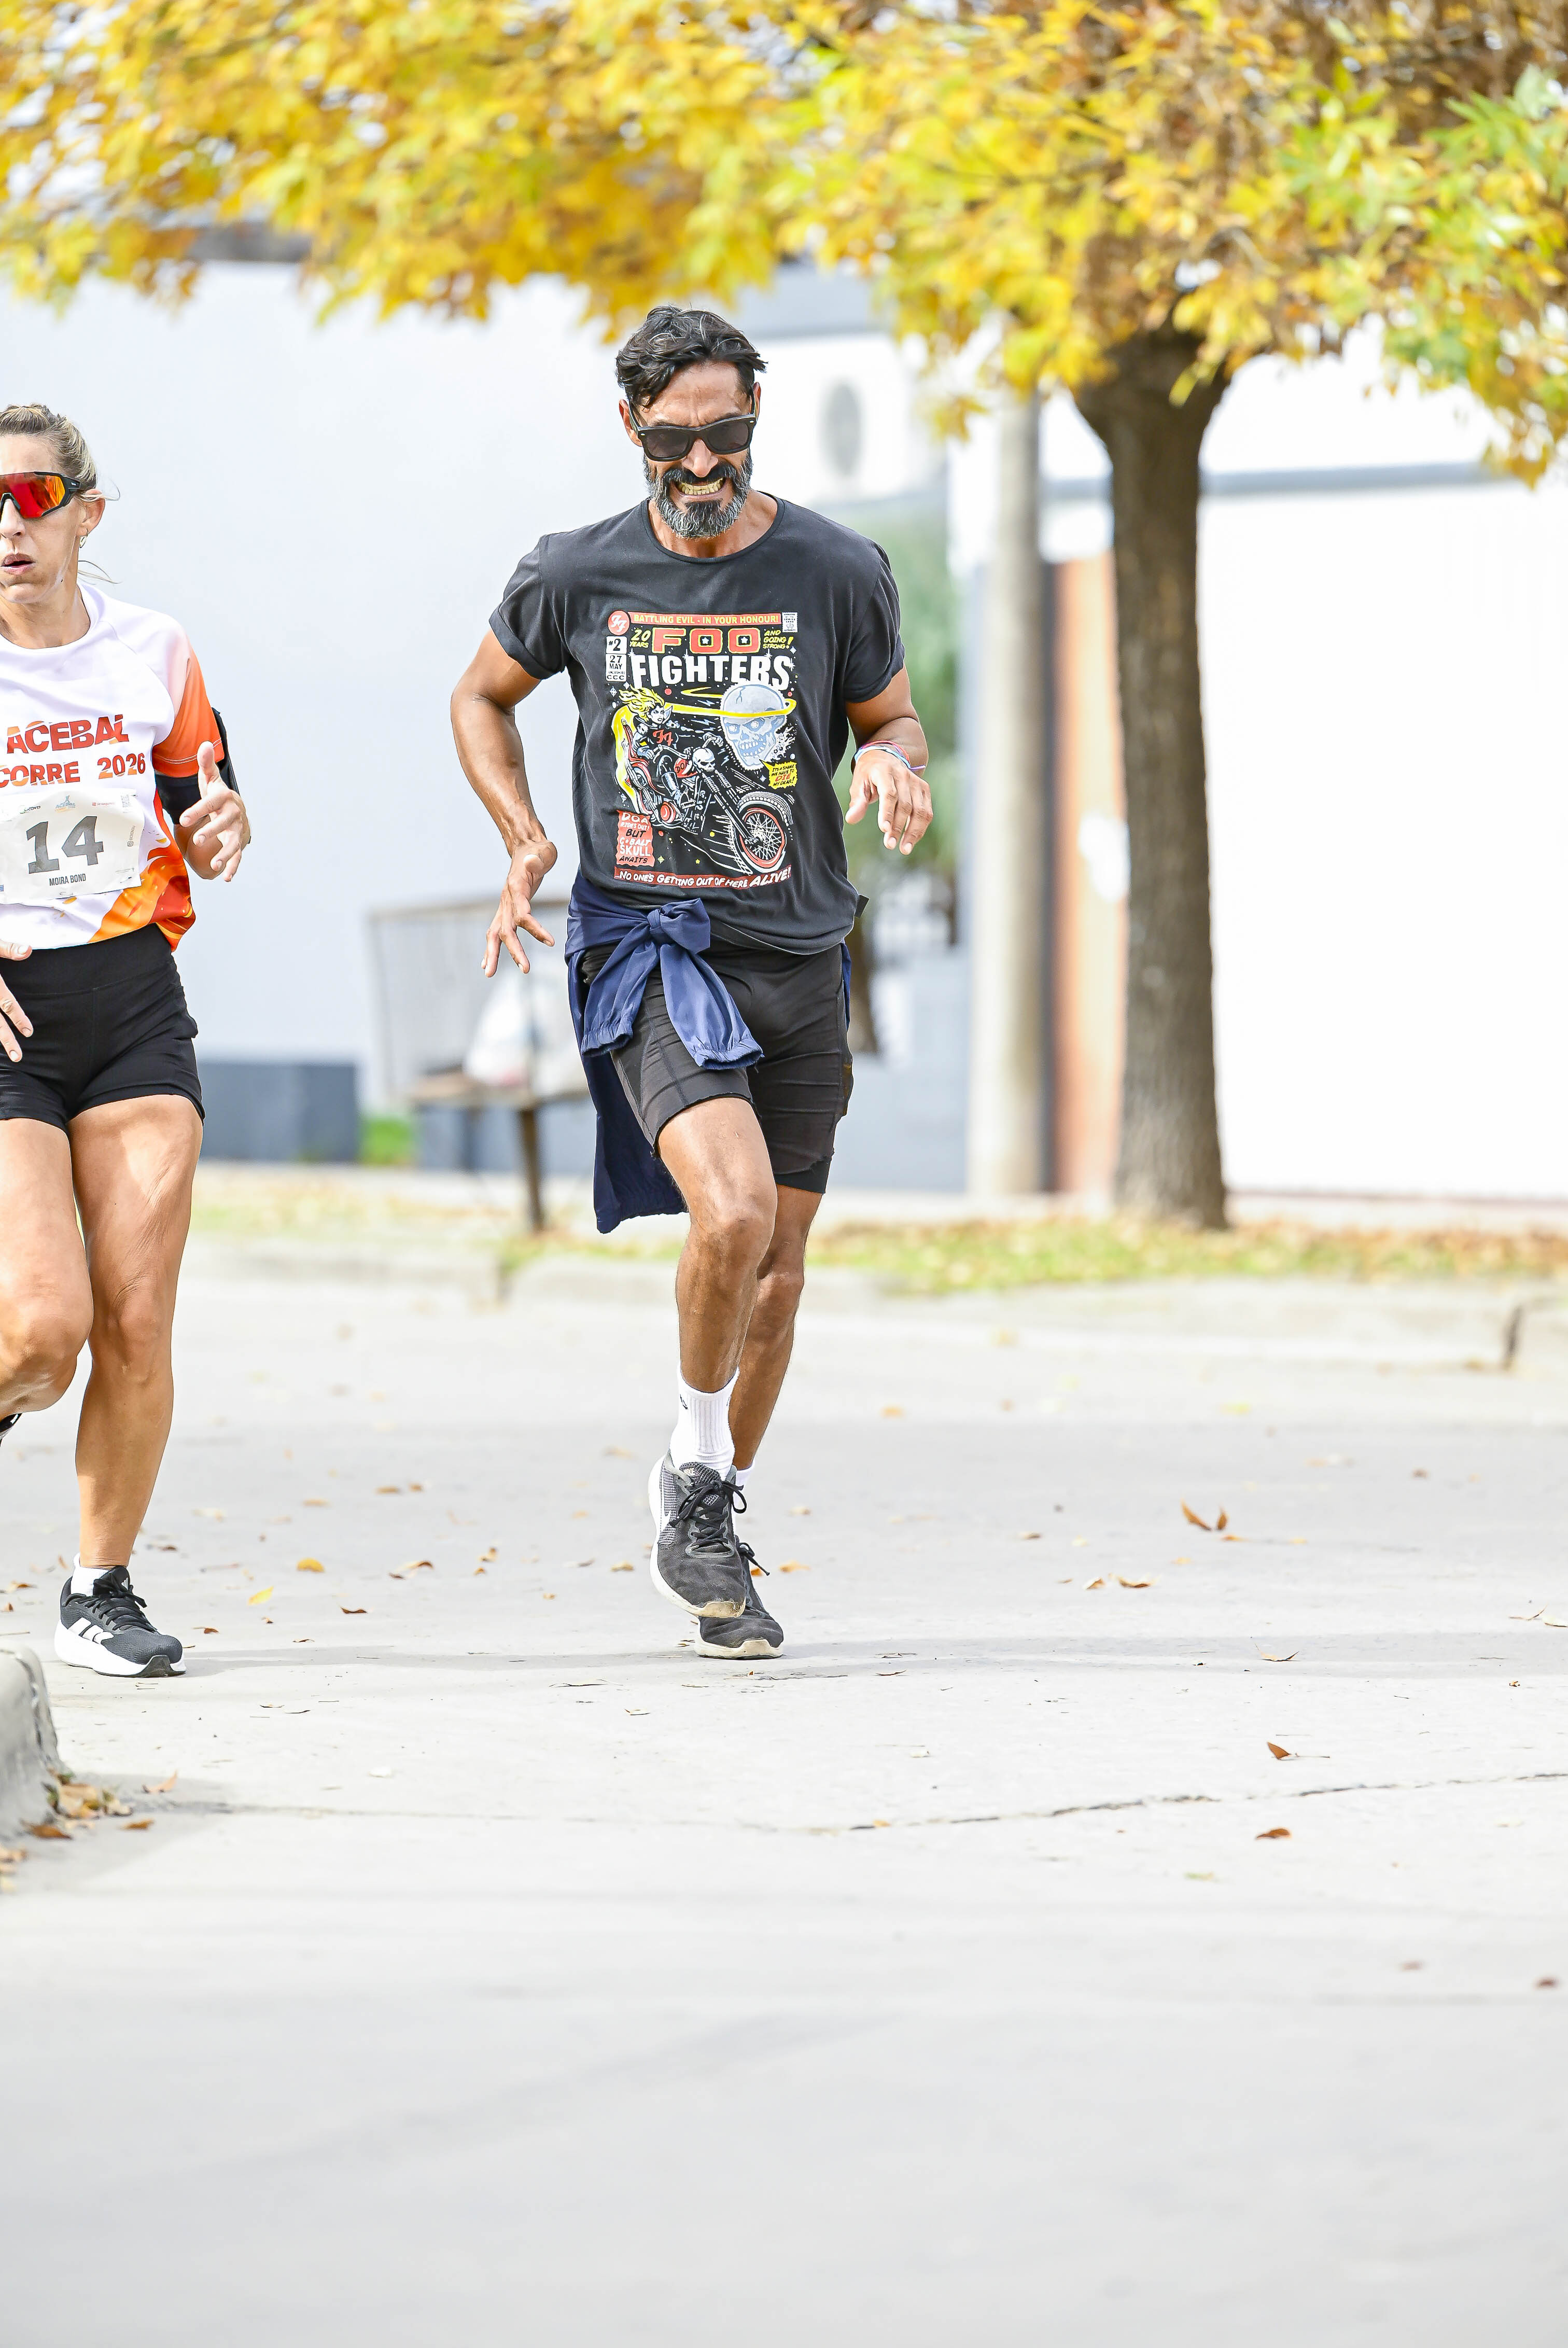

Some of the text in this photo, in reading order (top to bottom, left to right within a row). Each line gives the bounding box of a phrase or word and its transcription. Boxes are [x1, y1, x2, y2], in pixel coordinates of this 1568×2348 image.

[634, 614, 674, 623] BATTLING
[739, 615, 778, 623] HONOUR!
[631, 629, 651, 642] 20
[652, 627, 761, 654] FOO
[608, 638, 621, 651] #2
[629, 640, 649, 649] YEARS
[610, 655, 622, 663] 27
[631, 654, 791, 691] FIGHTERS
[7, 714, 130, 754] ACEBAL
[0, 752, 146, 788] CORRE 2026
[625, 829, 647, 838] BUT
[26, 816, 104, 874] 14
[620, 845, 651, 857] SKULL
[619, 855, 648, 863] AWAITS
[49, 873, 86, 886] MOIRA BOND
[633, 873, 655, 883] ONE'S
[656, 874, 695, 887] GETTING
[696, 877, 714, 886] OUT
[715, 877, 726, 887] OF
[724, 878, 748, 888] HERE
[749, 866, 792, 887] ALIVE!
